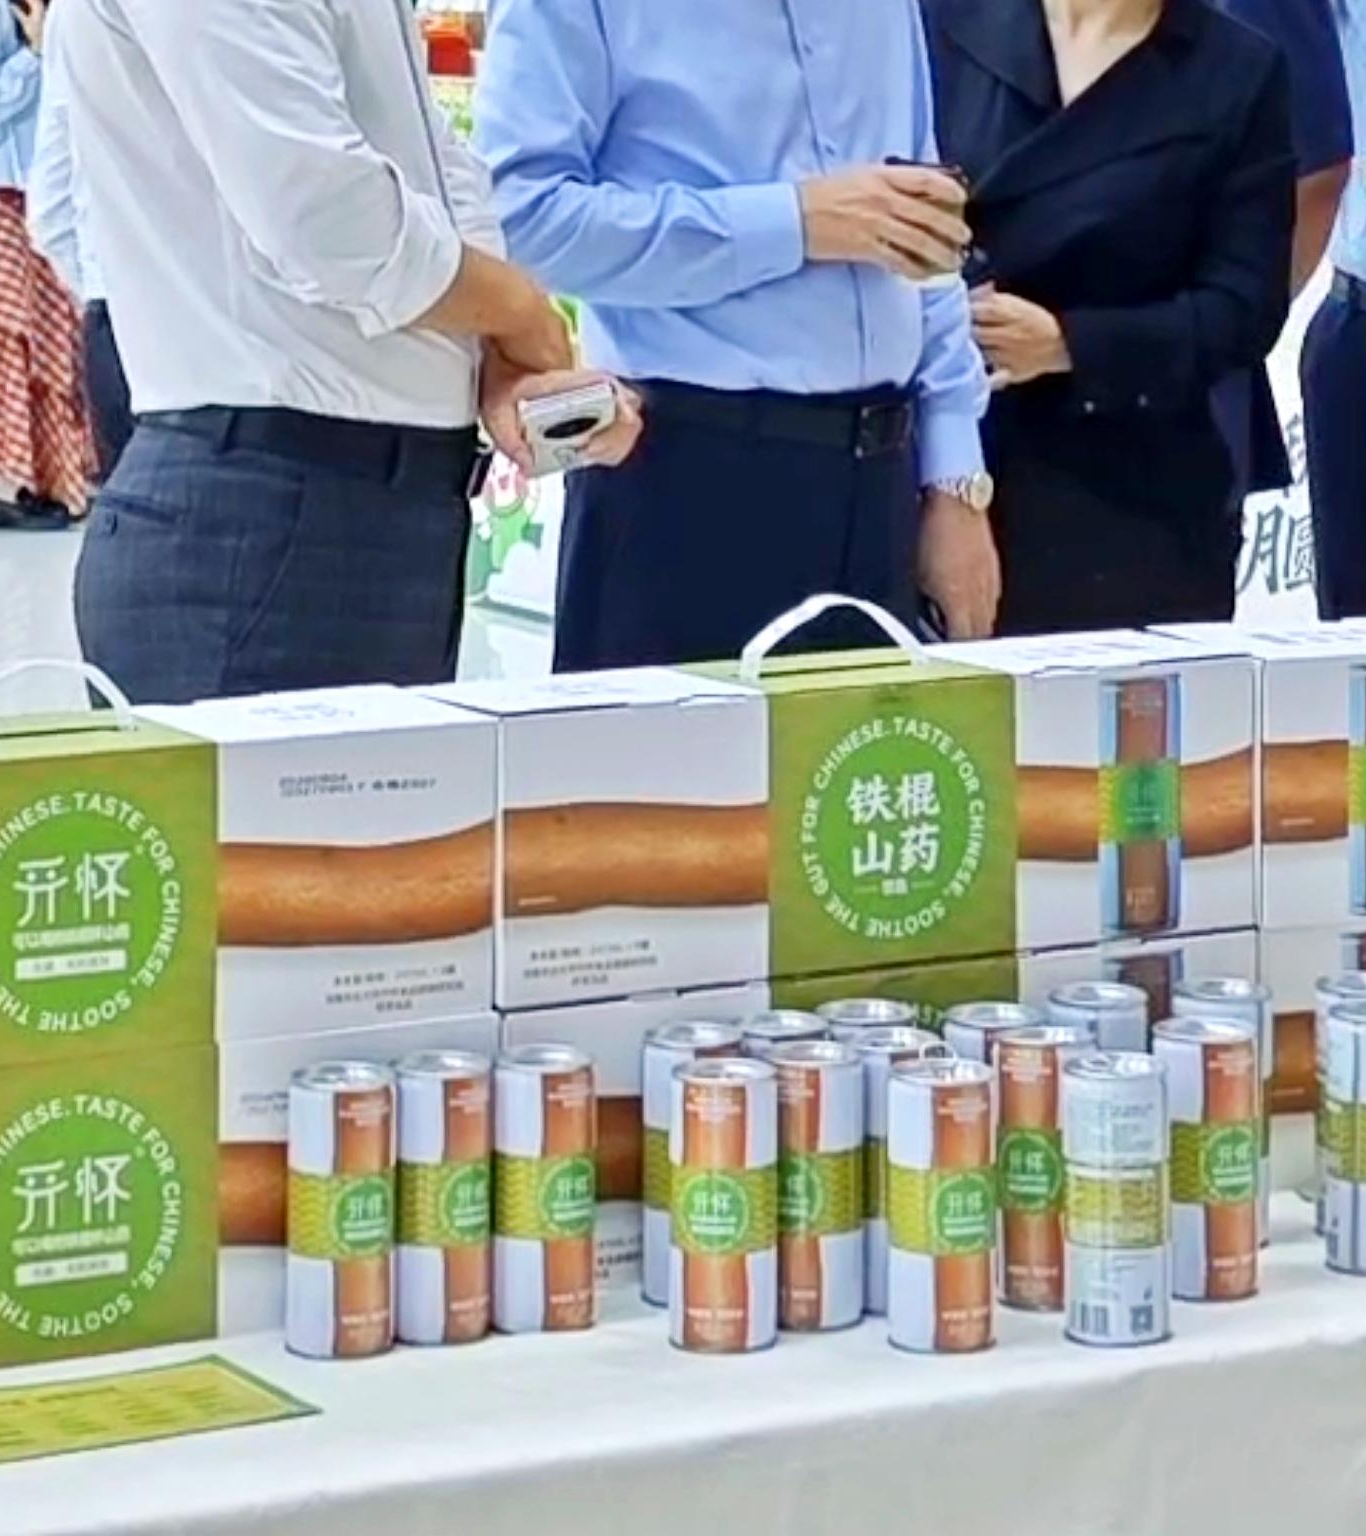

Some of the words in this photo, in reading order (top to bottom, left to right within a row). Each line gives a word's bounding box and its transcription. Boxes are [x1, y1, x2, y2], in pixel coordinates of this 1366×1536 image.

[846, 771, 941, 824] 铁棍
[851, 822, 940, 878] 山药
[12, 851, 132, 927] 开怀
[12, 1154, 132, 1232] 开怀
